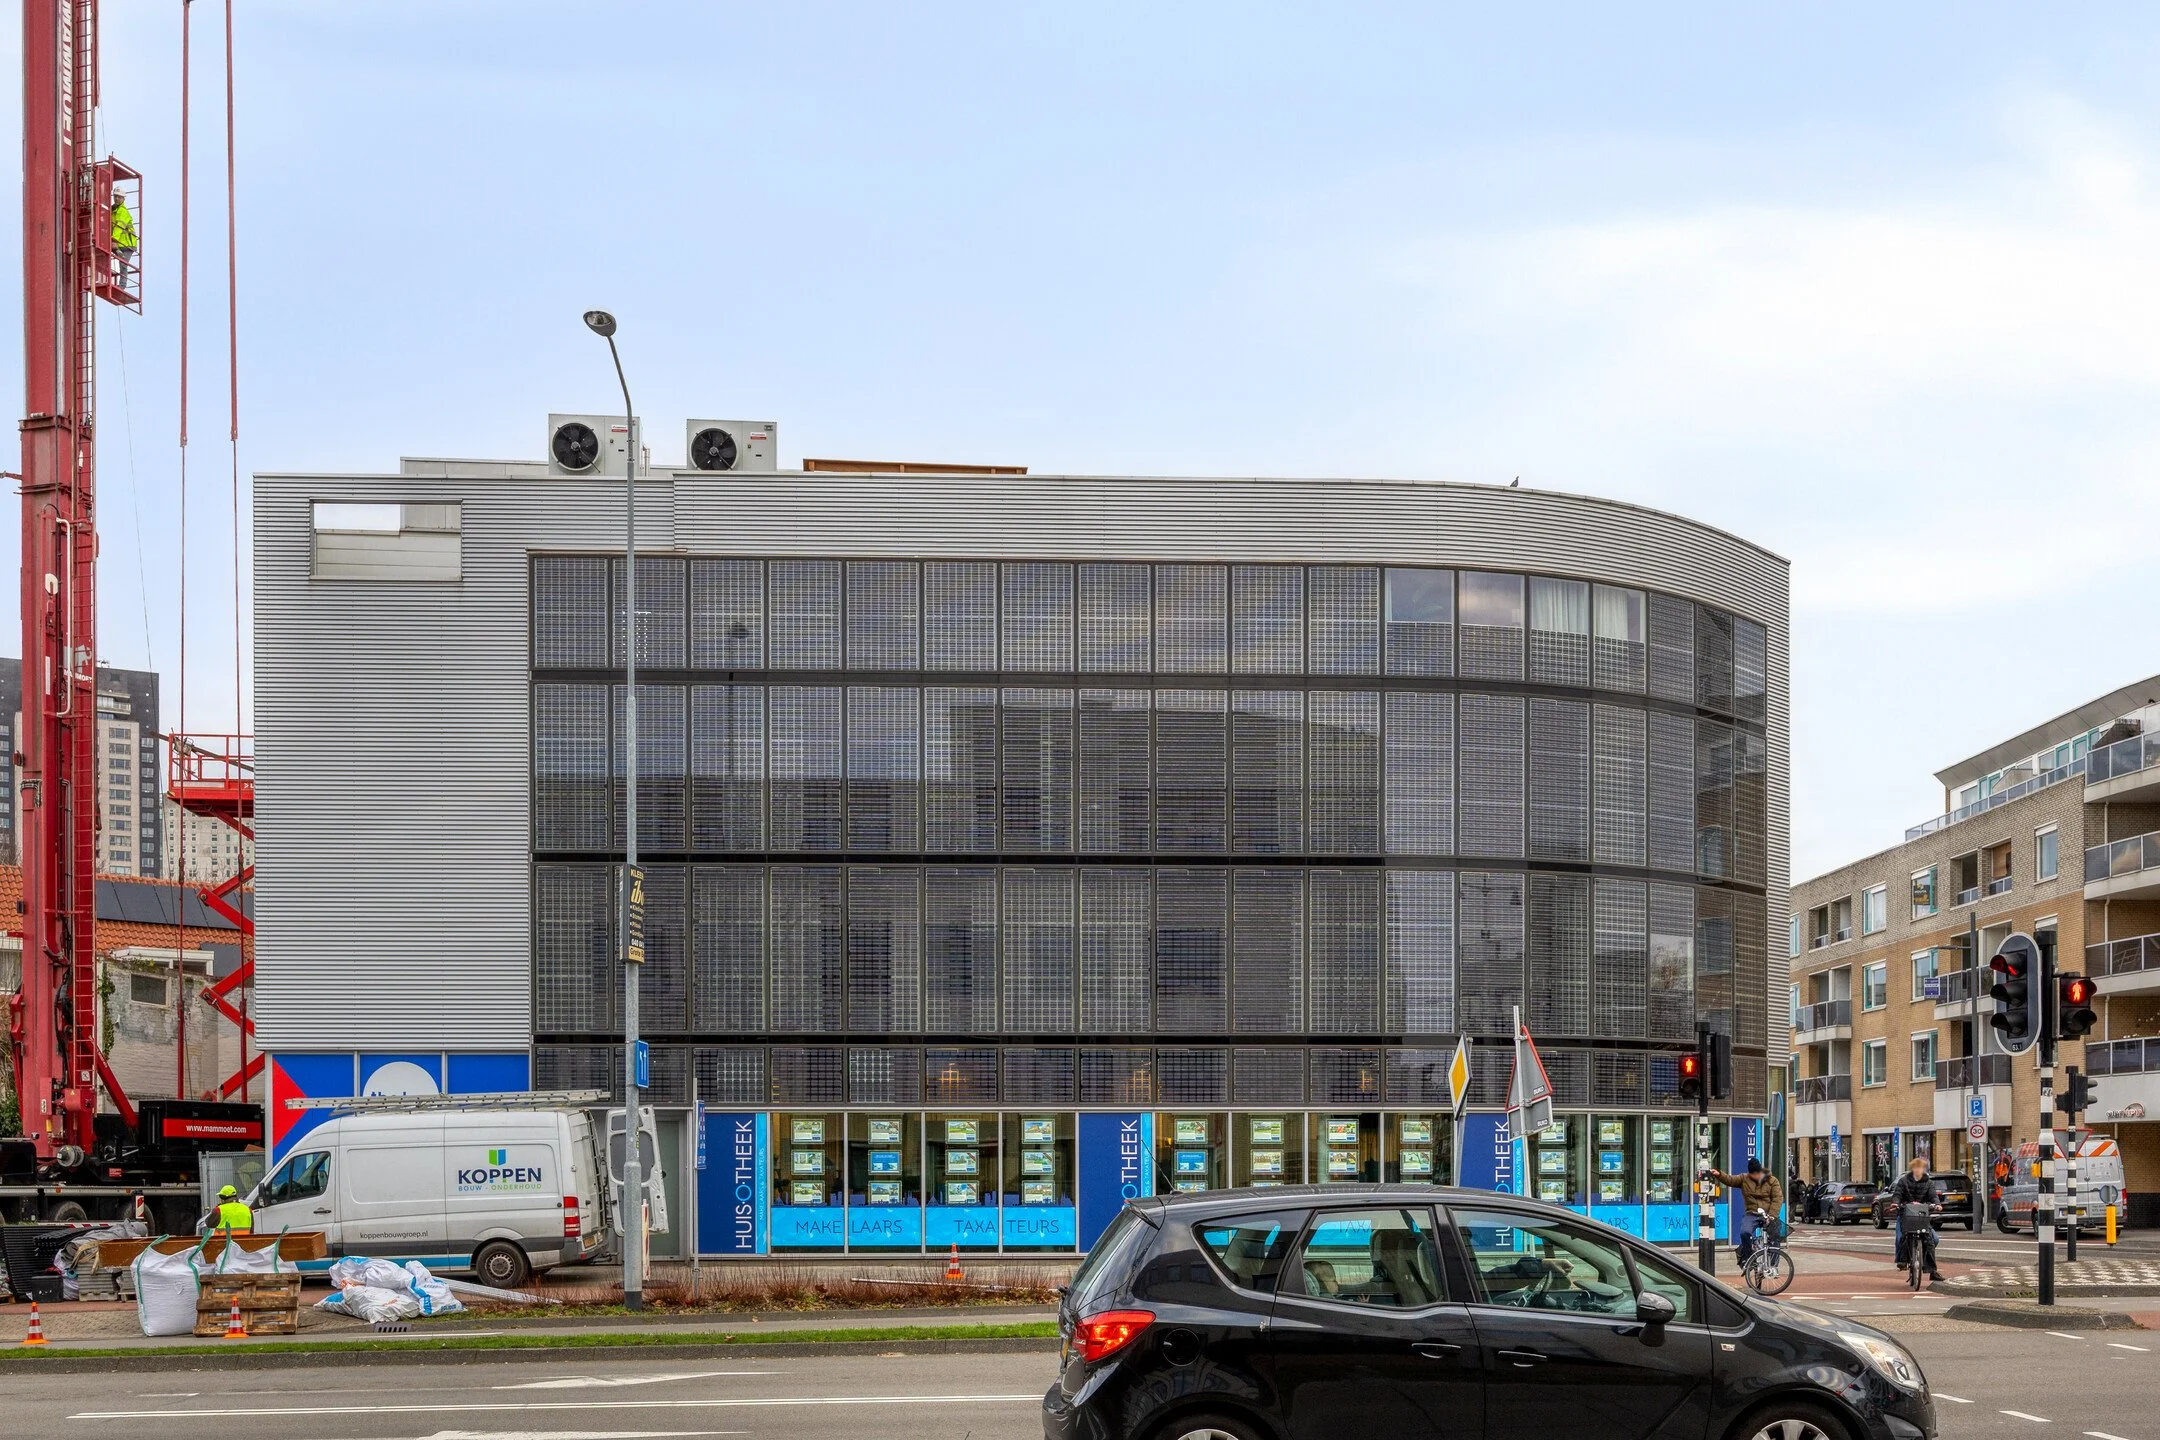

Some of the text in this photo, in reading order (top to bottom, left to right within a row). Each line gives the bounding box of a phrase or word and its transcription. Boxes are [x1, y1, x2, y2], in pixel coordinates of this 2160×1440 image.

[186, 1124, 247, 1134] www.mammoet.com
[458, 1168, 542, 1184] KOPPEN
[491, 1183, 542, 1191] ONDERHOUD
[360, 1230, 429, 1240] koppenbouwgroep.nl
